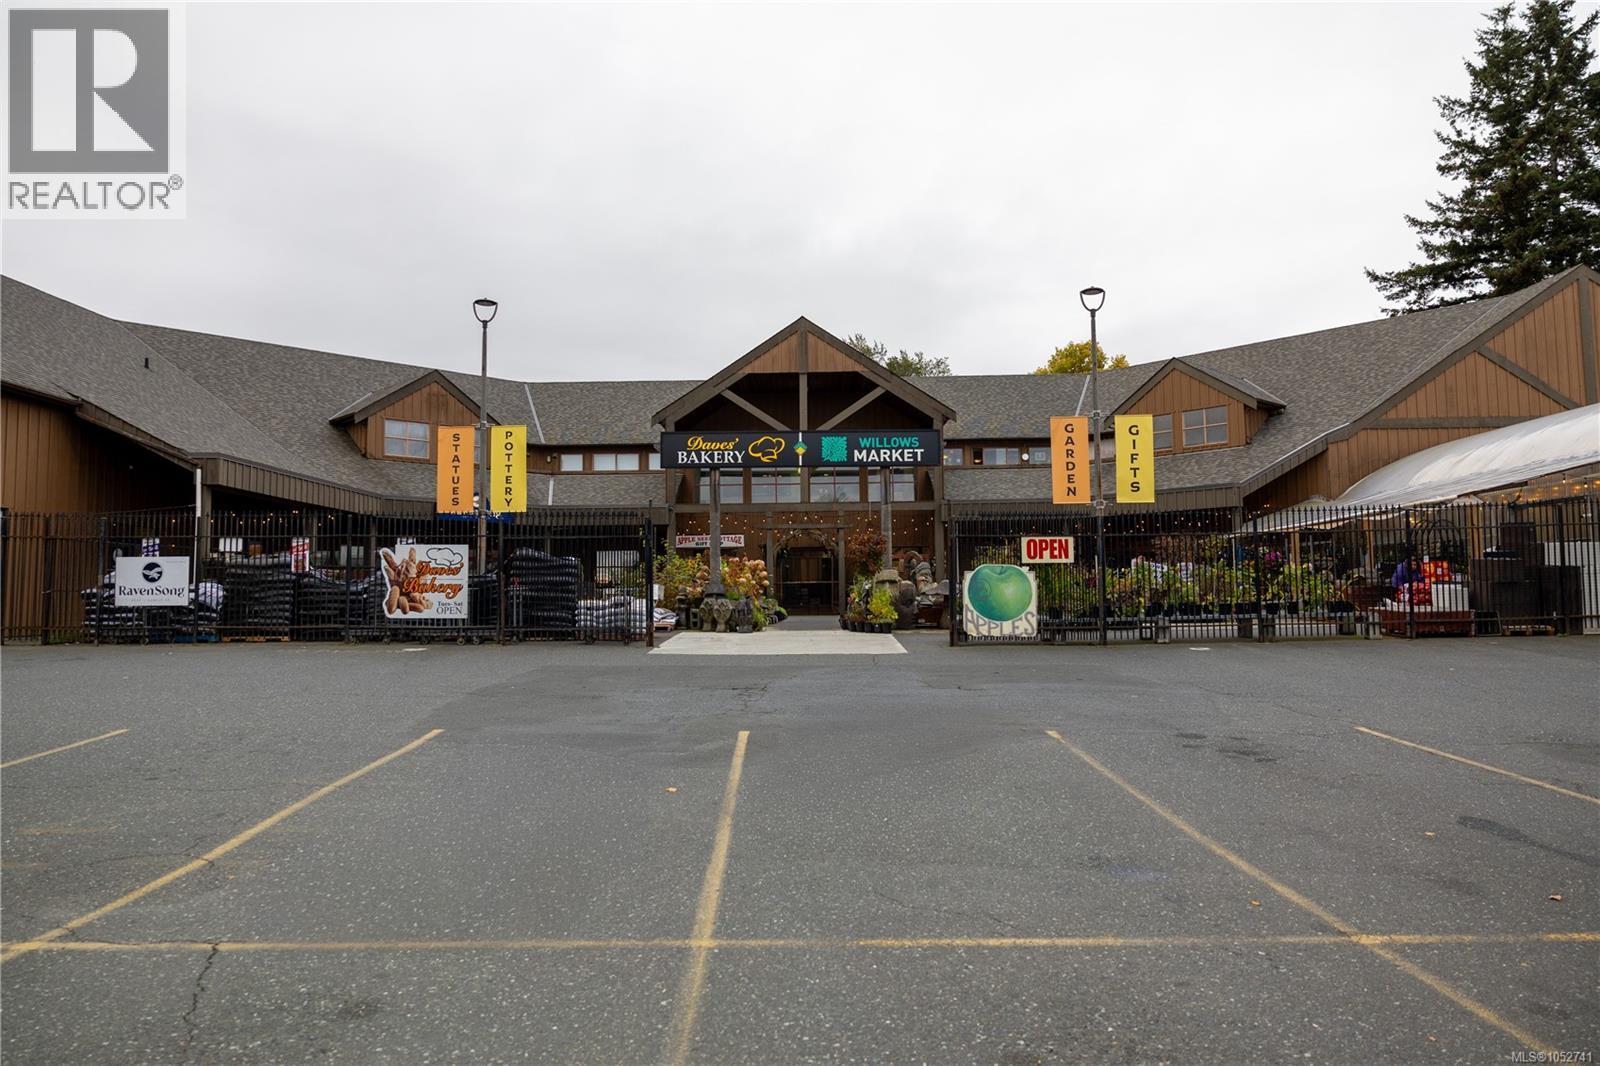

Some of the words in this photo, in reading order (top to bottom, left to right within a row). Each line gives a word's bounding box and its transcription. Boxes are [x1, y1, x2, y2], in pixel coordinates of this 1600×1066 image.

[859, 437, 920, 449] WILLOWS
[677, 450, 745, 464] BAKERY
[853, 449, 925, 463] MARKET
[1064, 423, 1077, 496] GARDEN
[1128, 425, 1140, 493] GIFTS
[451, 433, 461, 506] STATUES
[504, 431, 514, 507] POTTERY
[677, 536, 695, 545] APPLE
[1026, 538, 1070, 560] OPEN
[118, 585, 186, 598] RavenSong
[402, 577, 464, 600] Bakery
[436, 606, 463, 615] OPEN
[964, 603, 1037, 636] APPLES
